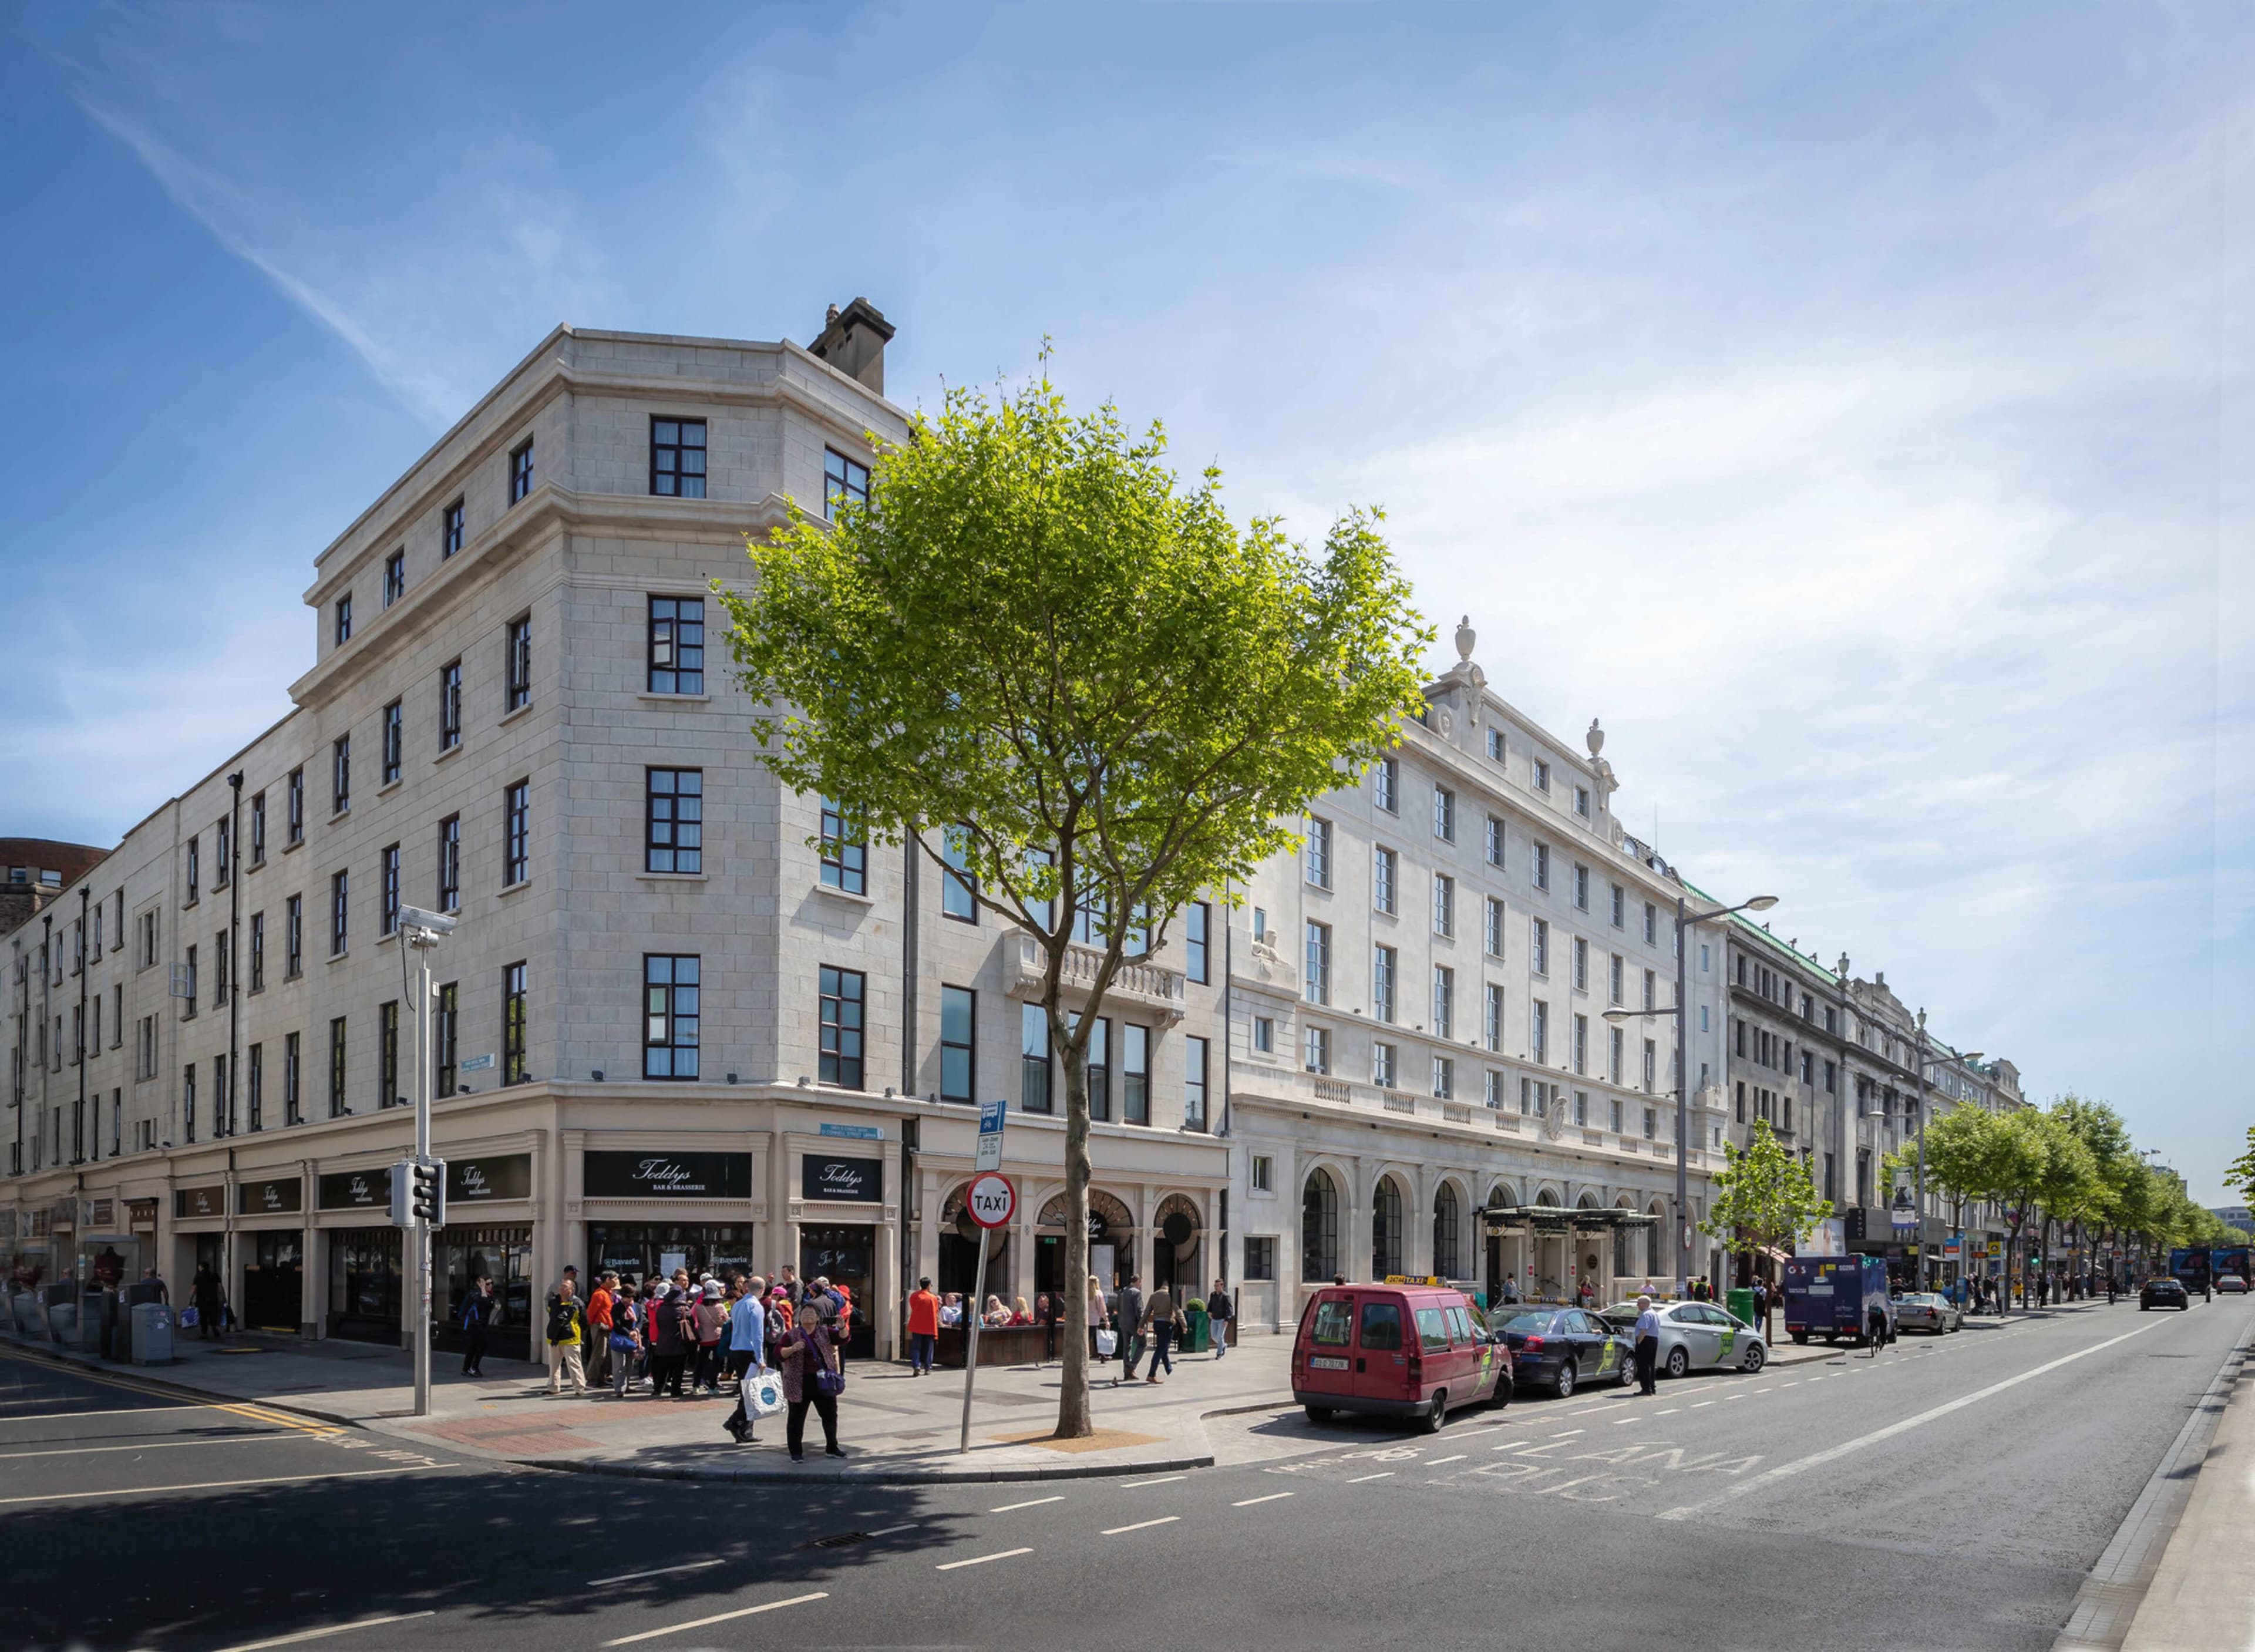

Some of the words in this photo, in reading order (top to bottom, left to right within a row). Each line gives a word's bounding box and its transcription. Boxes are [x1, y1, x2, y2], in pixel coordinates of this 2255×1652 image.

[632, 1159, 691, 1185] Toddys
[819, 1164, 863, 1188] Toddys
[975, 1195, 1007, 1212] TAXI
